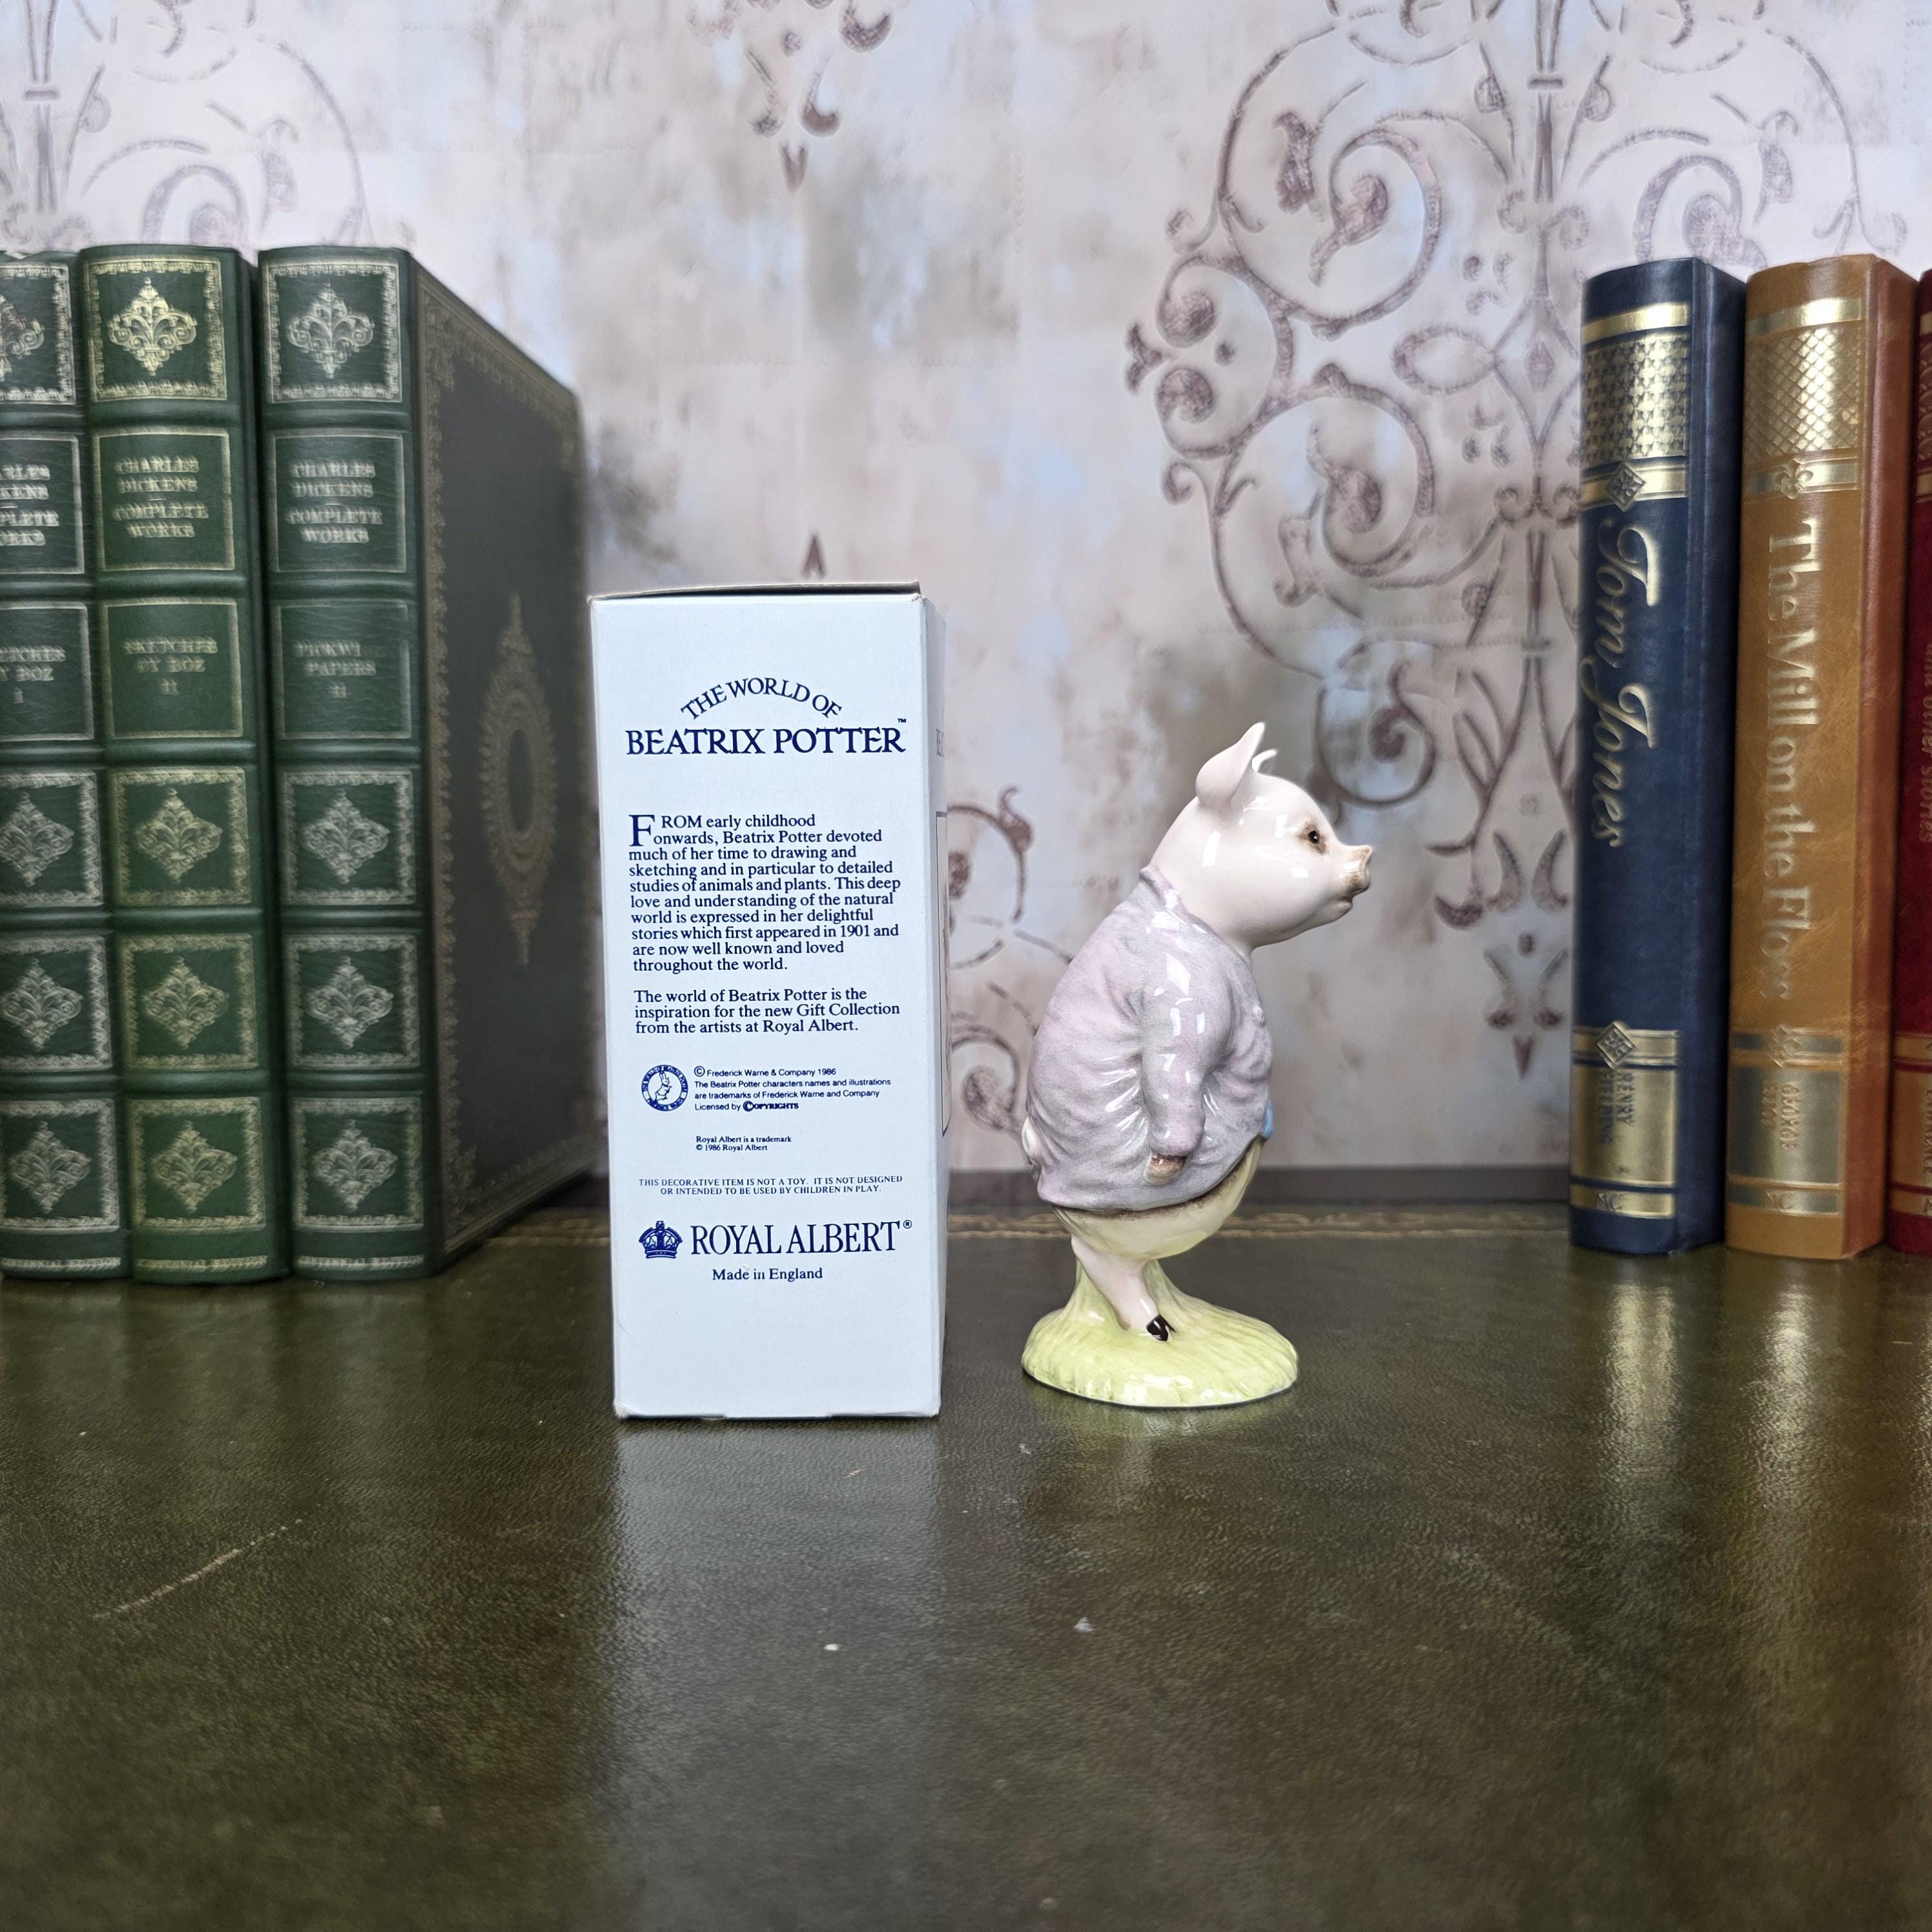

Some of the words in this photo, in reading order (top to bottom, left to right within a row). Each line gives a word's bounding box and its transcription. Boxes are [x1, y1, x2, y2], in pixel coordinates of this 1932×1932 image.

[1768, 519, 1822, 621] The
[1594, 519, 1660, 668] Tom
[1767, 629, 1820, 729] Mill
[681, 684, 727, 721] THE
[726, 677, 811, 703] WORLD
[812, 694, 843, 719] OF
[625, 728, 766, 755] BEATRIX
[1580, 654, 1658, 847] Jones
[1765, 735, 1797, 792] on
[706, 814, 741, 831] early
[745, 814, 816, 827] childhood
[653, 830, 719, 847] onwards,
[723, 830, 775, 844] Beatrix
[778, 830, 823, 843] Potter
[826, 829, 883, 842] devoted
[1763, 804, 1818, 878] the
[628, 847, 668, 861] much
[672, 847, 688, 860] of
[690, 847, 714, 860] her
[717, 846, 749, 859] time
[753, 848, 767, 859] to
[770, 845, 828, 862] drawing
[831, 845, 857, 858] and
[629, 863, 697, 881] sketching
[701, 862, 726, 876] and
[730, 862, 744, 875] in
[748, 861, 816, 879] particular
[819, 863, 834, 874] to
[838, 860, 893, 874] detailed
[630, 879, 679, 892] studies
[682, 879, 697, 892] of
[699, 878, 754, 892] animals
[755, 878, 782, 890] and
[784, 877, 831, 894] plants.
[834, 877, 866, 890] This
[867, 876, 901, 893] deep
[630, 895, 661, 908] love
[664, 894, 691, 908] and
[694, 894, 797, 910] understanding
[800, 893, 816, 906] of
[818, 892, 841, 906] the
[844, 892, 894, 905] natural
[630, 910, 672, 924] world
[676, 910, 687, 923] is
[690, 909, 760, 927] expressed
[763, 909, 777, 922] in
[780, 909, 804, 922] her
[807, 908, 874, 925] delightful
[632, 927, 679, 940] stories
[680, 926, 723, 940] which
[724, 925, 753, 939] first
[755, 925, 821, 942] appeared
[823, 925, 837, 938] in
[840, 924, 870, 938] 1901
[873, 923, 899, 936] and
[633, 946, 655, 956] are
[659, 946, 689, 956] now
[692, 941, 721, 955] well
[724, 941, 773, 954] known
[776, 941, 803, 954] and
[805, 940, 845, 954] loved
[633, 958, 714, 975] throughout
[717, 958, 739, 971] the
[743, 957, 788, 970] world.
[633, 990, 663, 1003] The
[666, 989, 706, 1002] world
[710, 989, 726, 1002] of
[728, 989, 780, 1002] Beatrix
[783, 989, 828, 1001] Potter
[831, 987, 842, 1000] is
[845, 987, 867, 1000] the
[635, 1005, 711, 1022] inspiration
[712, 1004, 735, 1018] for
[738, 1004, 761, 1018] the
[765, 1007, 793, 1017] new
[796, 1003, 826, 1016] Gift
[828, 1002, 900, 1016] Collection
[635, 1020, 670, 1034] from
[673, 1020, 696, 1033] the
[699, 1020, 742, 1033] artists
[745, 1022, 759, 1033] at
[762, 1019, 805, 1036] Royal
[808, 1018, 858, 1032] Albert.
[778, 1069, 816, 1077] Company
[848, 1078, 891, 1086] illustrations
[762, 1091, 798, 1100] Frederick
[843, 1089, 880, 1098] Company
[731, 1103, 741, 1112] by
[696, 1136, 717, 1145] Royal
[722, 1144, 743, 1153] Royal
[857, 1175, 903, 1184] DESIGNED
[794, 1186, 841, 1194] CHILDREN
[856, 1184, 881, 1193] PLAY.
[690, 1224, 782, 1255] ROYAL
[712, 1268, 750, 1280] Made
[753, 1268, 765, 1280] in
[768, 1267, 823, 1282] England
